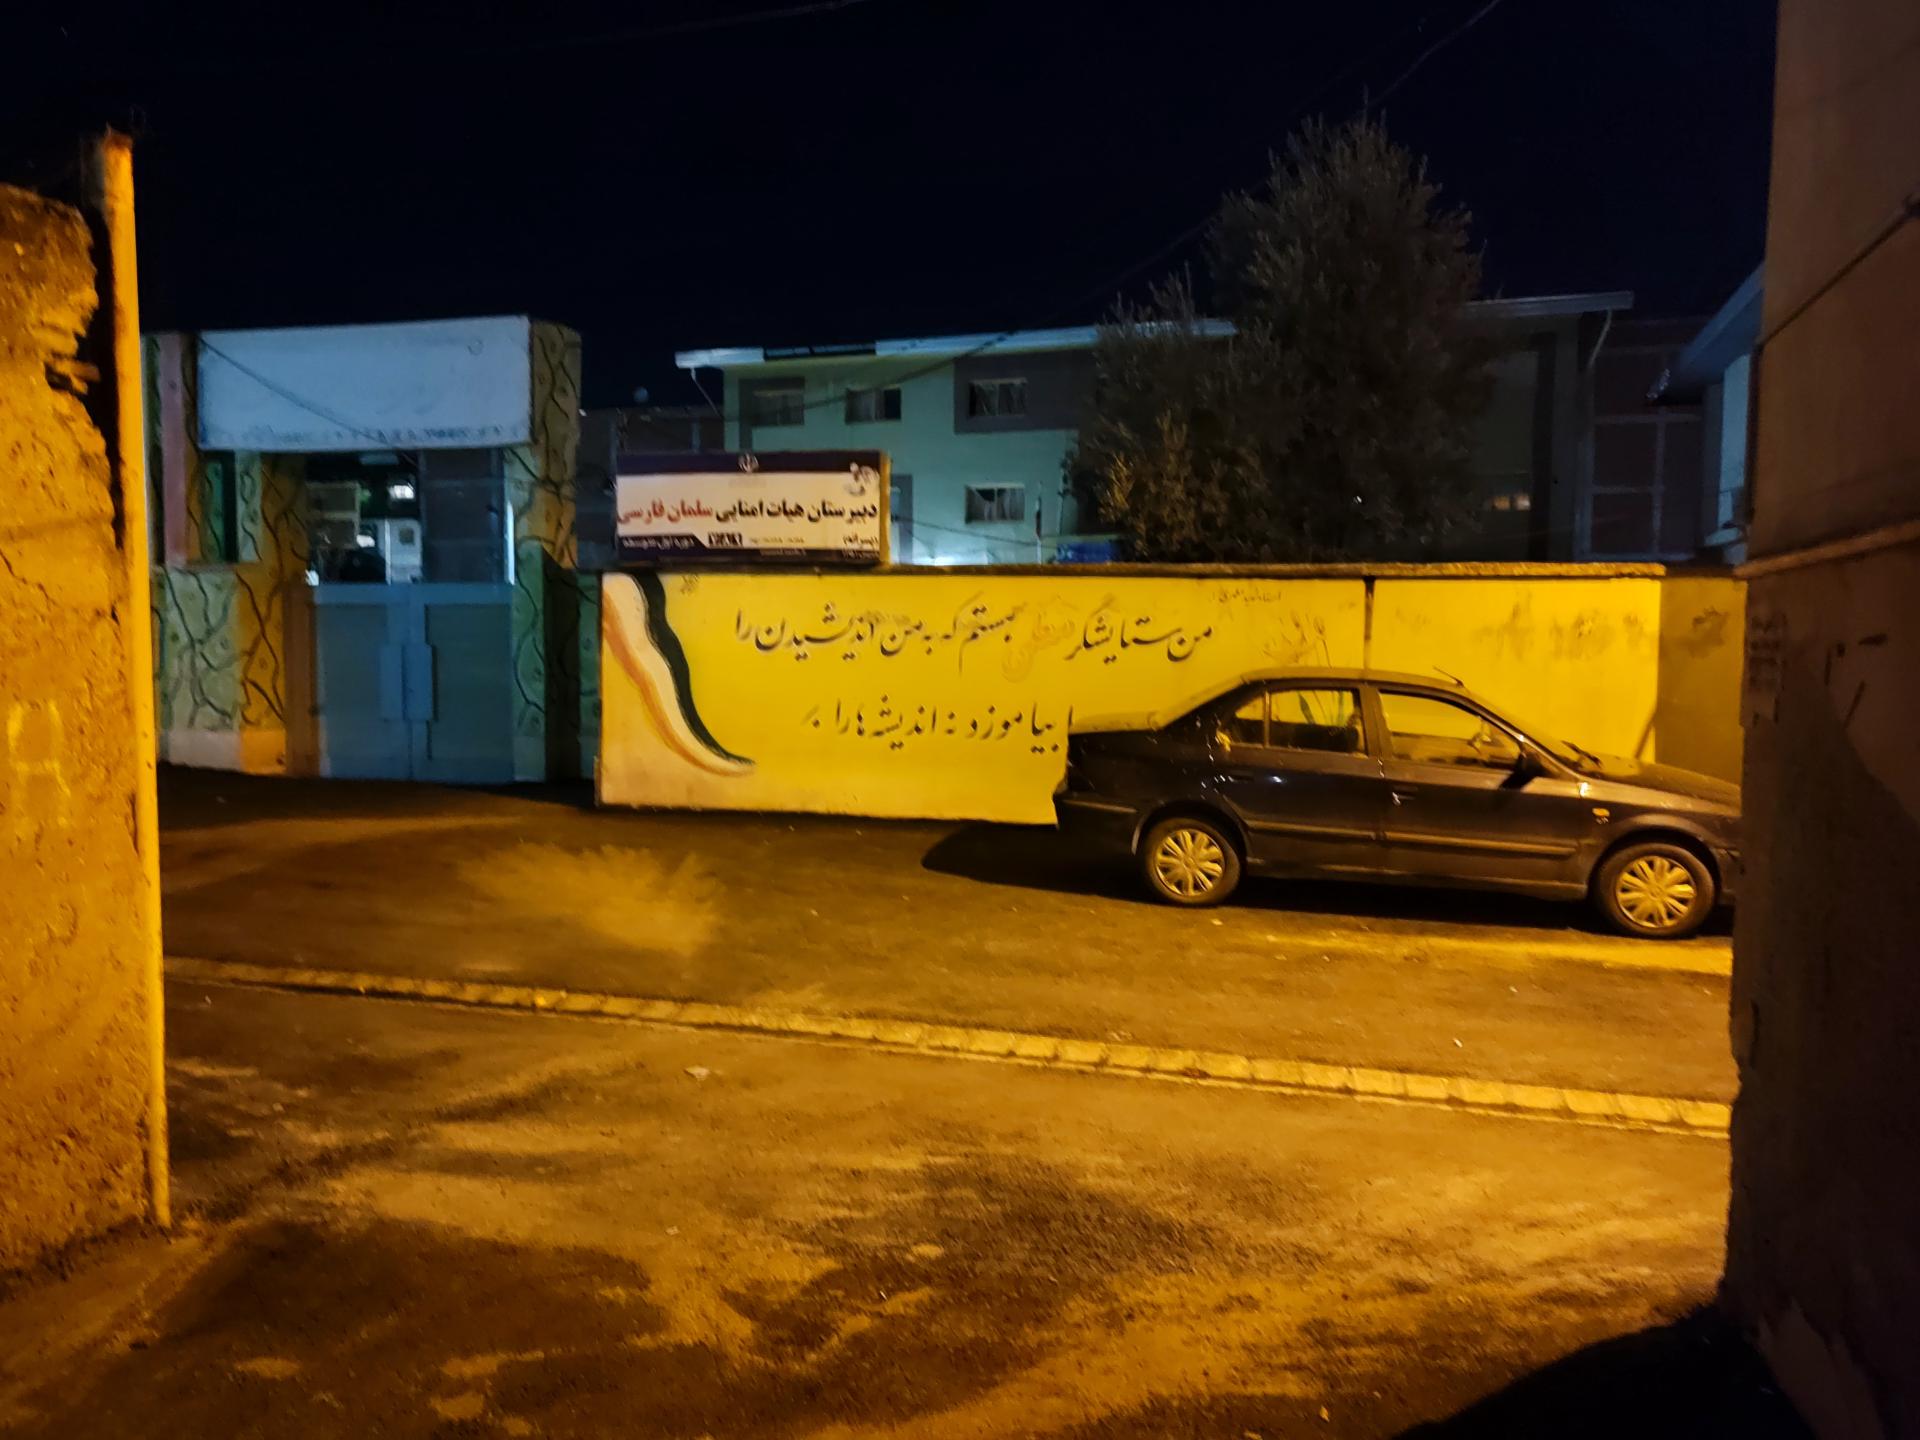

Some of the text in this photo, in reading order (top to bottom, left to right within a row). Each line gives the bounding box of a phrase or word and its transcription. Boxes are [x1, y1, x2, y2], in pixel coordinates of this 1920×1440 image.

[617, 497, 666, 526] فارسی
[667, 497, 714, 522] سلمان
[806, 497, 878, 526] دبیرستان
[734, 606, 754, 643] را
[753, 599, 876, 664] اندیشیدن
[1062, 592, 1186, 667] ستایشگر
[1166, 624, 1215, 663] من
[834, 696, 852, 737] را
